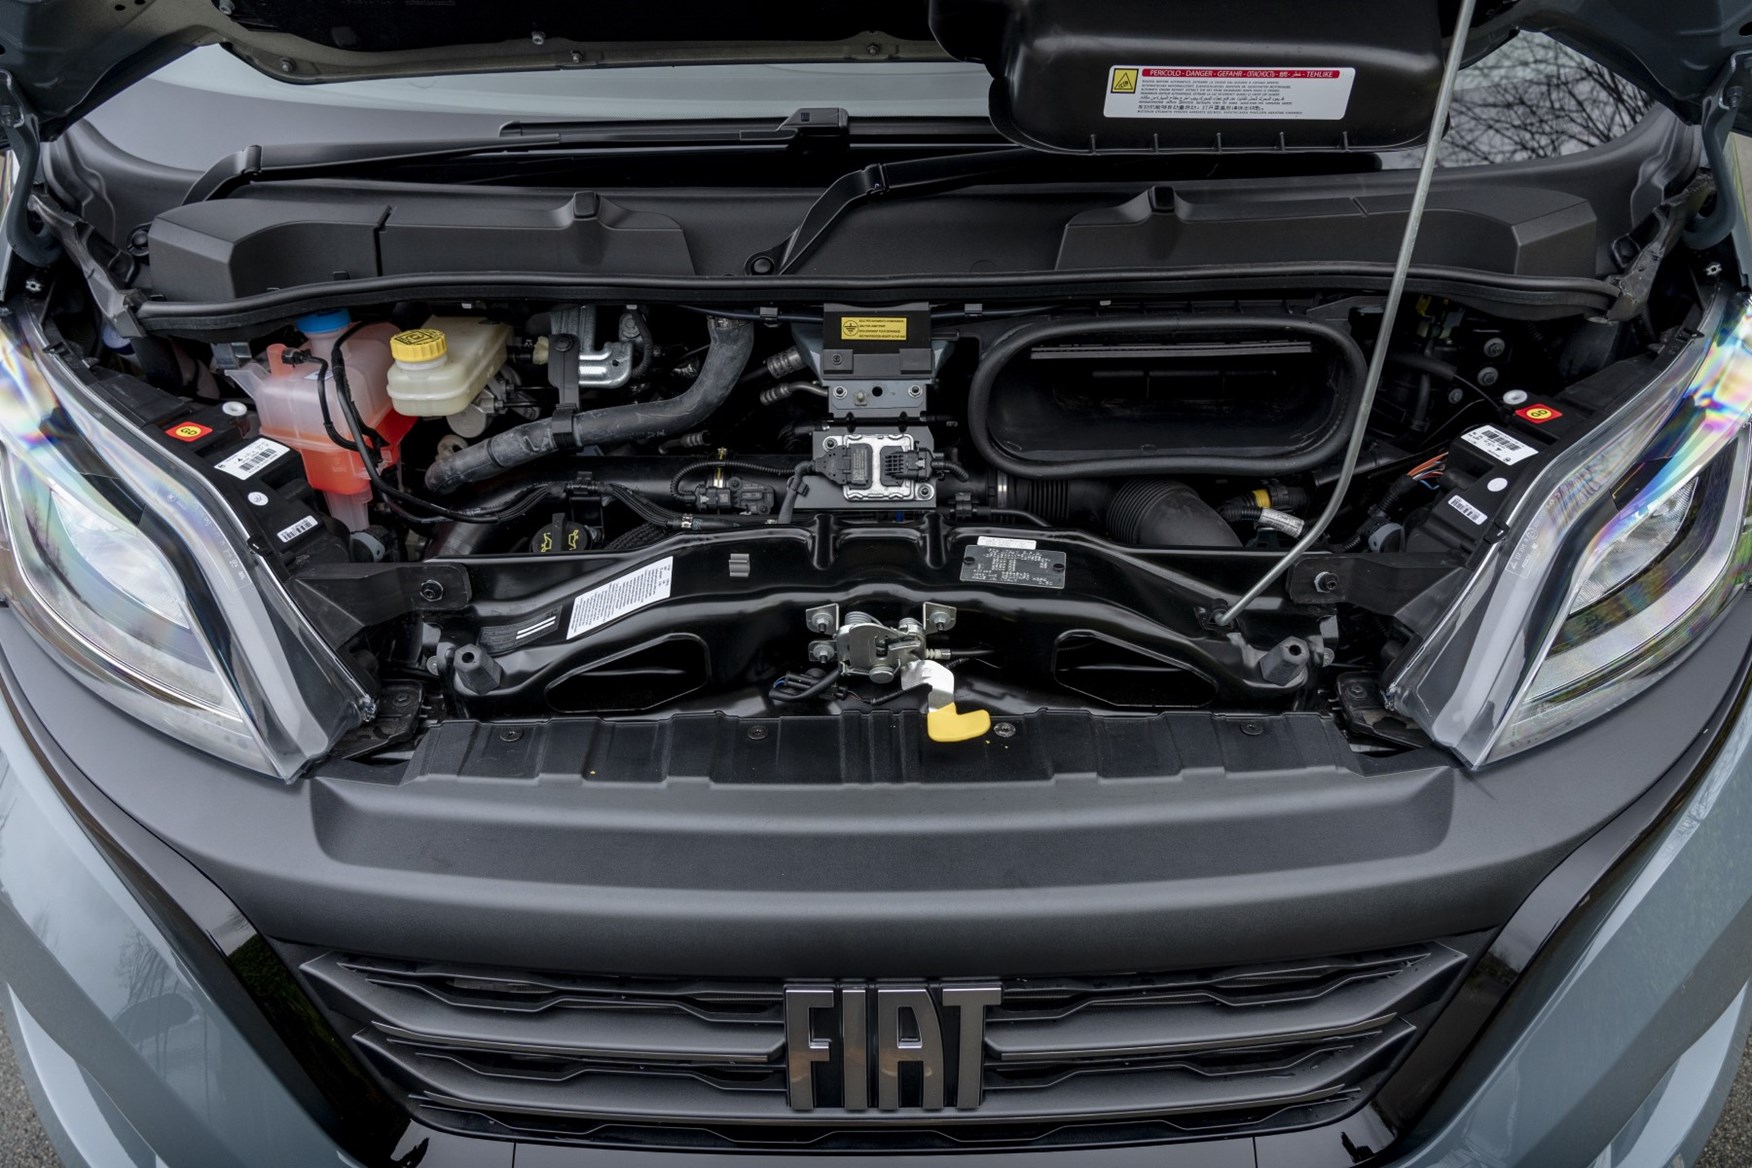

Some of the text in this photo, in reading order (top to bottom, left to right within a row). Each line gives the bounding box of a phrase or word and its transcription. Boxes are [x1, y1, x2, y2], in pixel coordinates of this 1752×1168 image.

[1149, 69, 1181, 77] PERICOLO
[1306, 70, 1334, 78] TEHLIKE
[784, 985, 1002, 1111] FIAT
